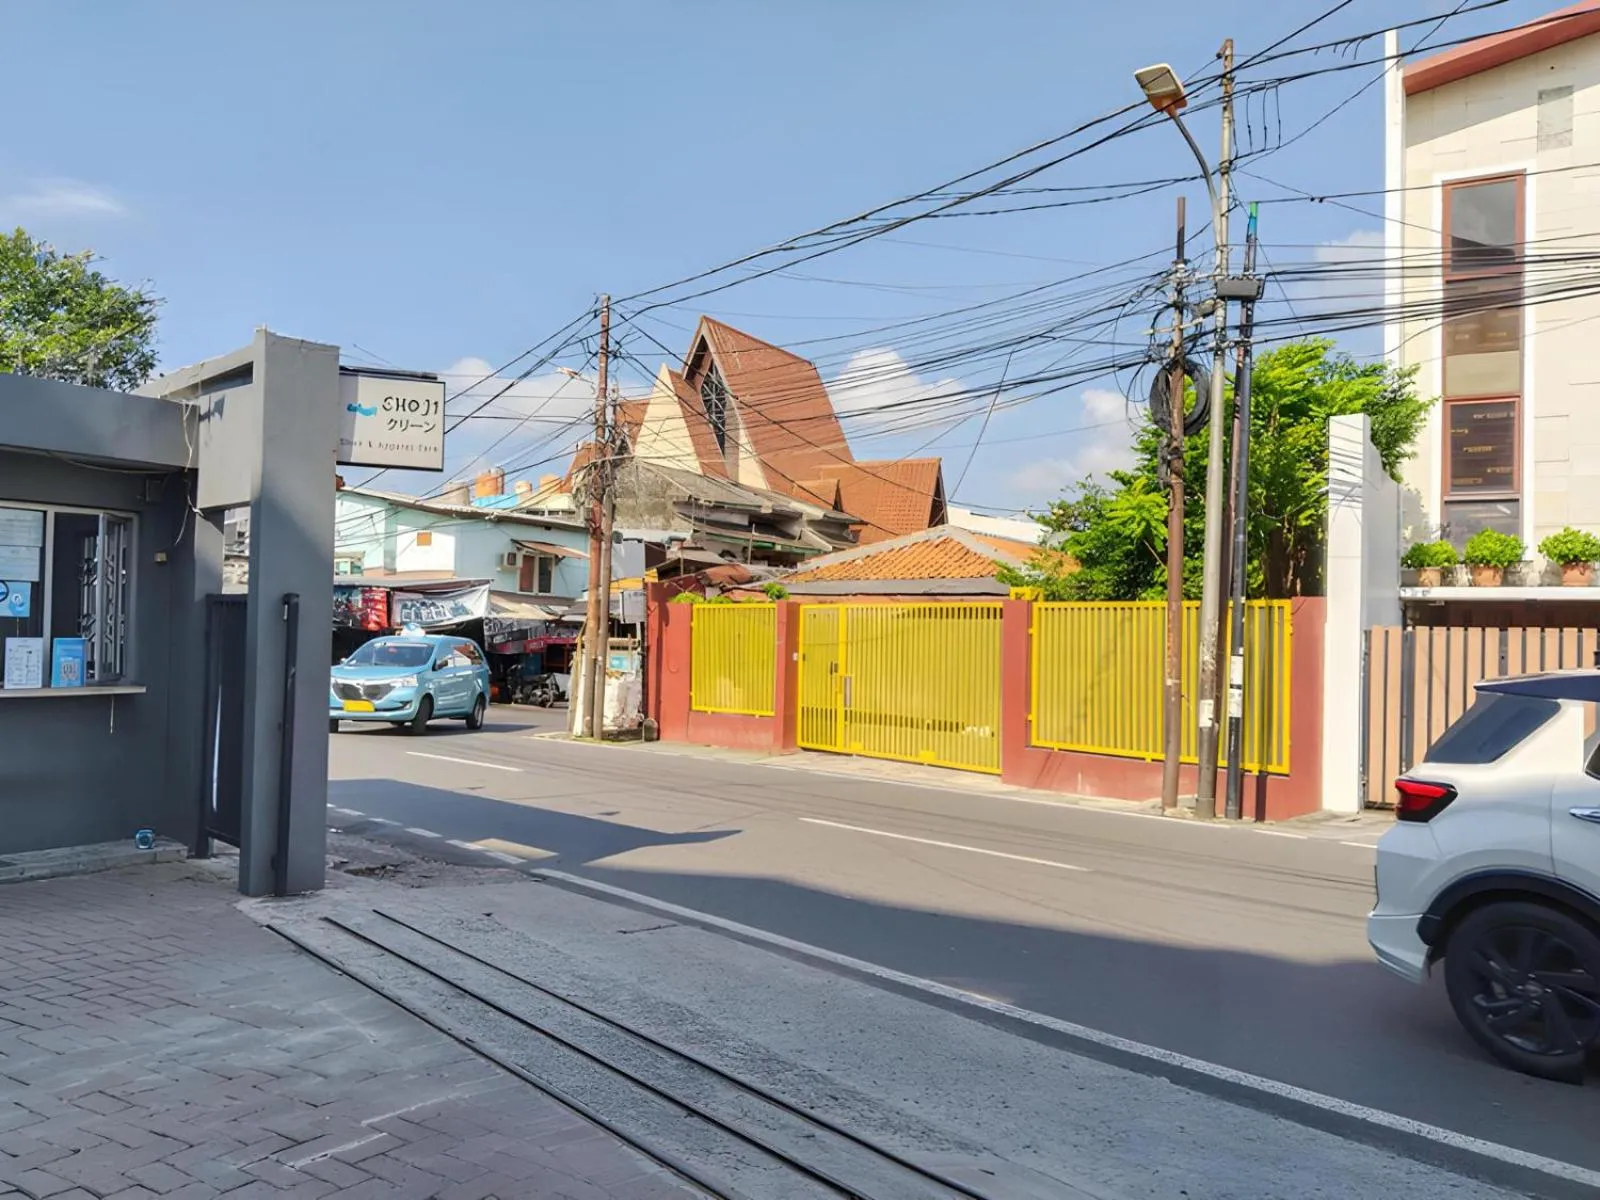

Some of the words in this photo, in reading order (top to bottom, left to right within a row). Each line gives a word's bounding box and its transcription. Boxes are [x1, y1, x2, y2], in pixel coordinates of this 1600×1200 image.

[382, 396, 438, 416] SHOJI
[387, 418, 436, 433] クリーン
